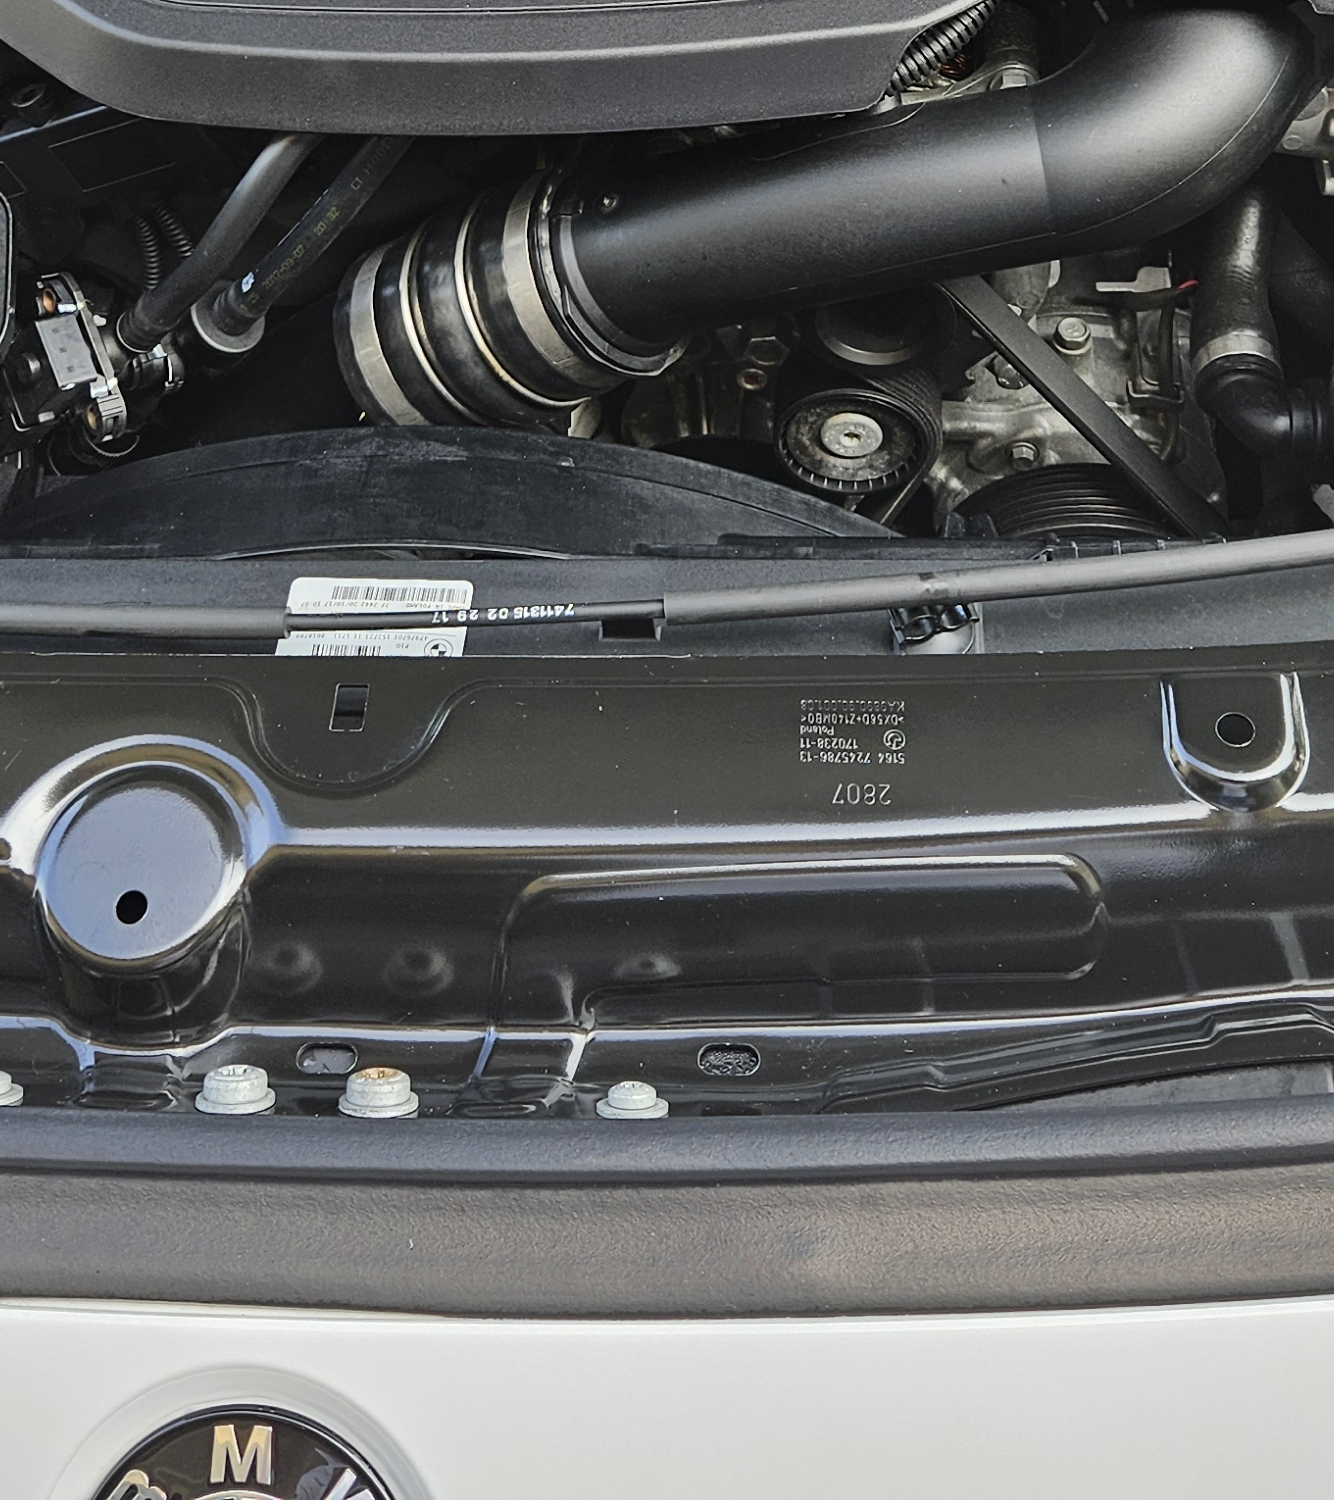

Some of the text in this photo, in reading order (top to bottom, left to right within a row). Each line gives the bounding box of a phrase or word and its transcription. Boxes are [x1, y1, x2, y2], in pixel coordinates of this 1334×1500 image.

[431, 611, 449, 623] 17
[487, 607, 509, 620] 02
[513, 604, 575, 619] 7411315
[800, 725, 834, 735] Poland
[799, 737, 858, 749] 170238-11
[799, 751, 905, 764] 5164 7245786-13
[832, 783, 891, 805] 2807
